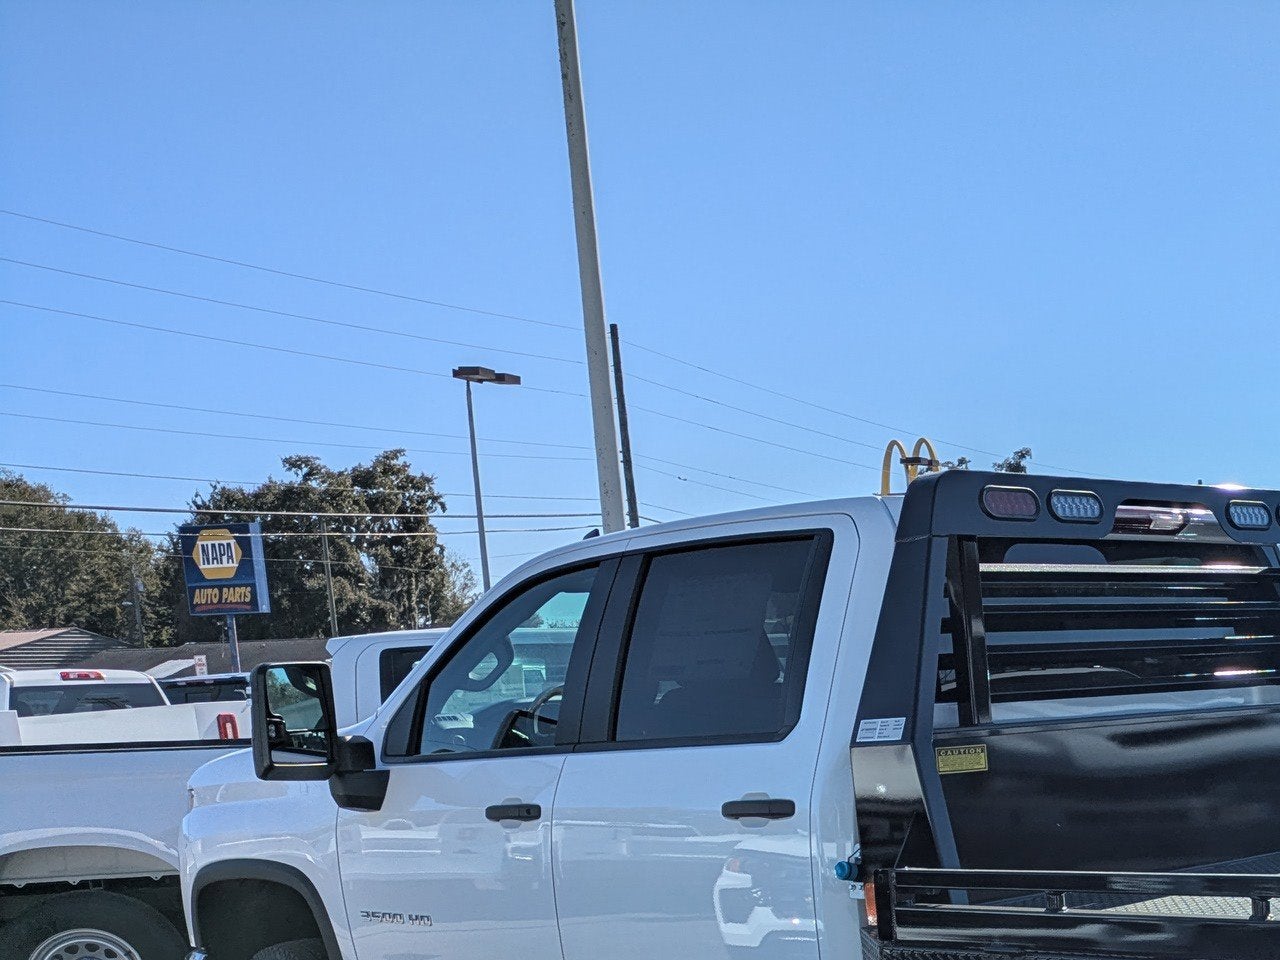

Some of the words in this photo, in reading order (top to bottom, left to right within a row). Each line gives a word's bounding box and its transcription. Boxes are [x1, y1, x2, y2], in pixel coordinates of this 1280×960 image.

[201, 542, 235, 565] NAPA
[193, 588, 219, 604] AUTO
[222, 587, 251, 603] PARTS
[940, 748, 982, 756] CAUTION
